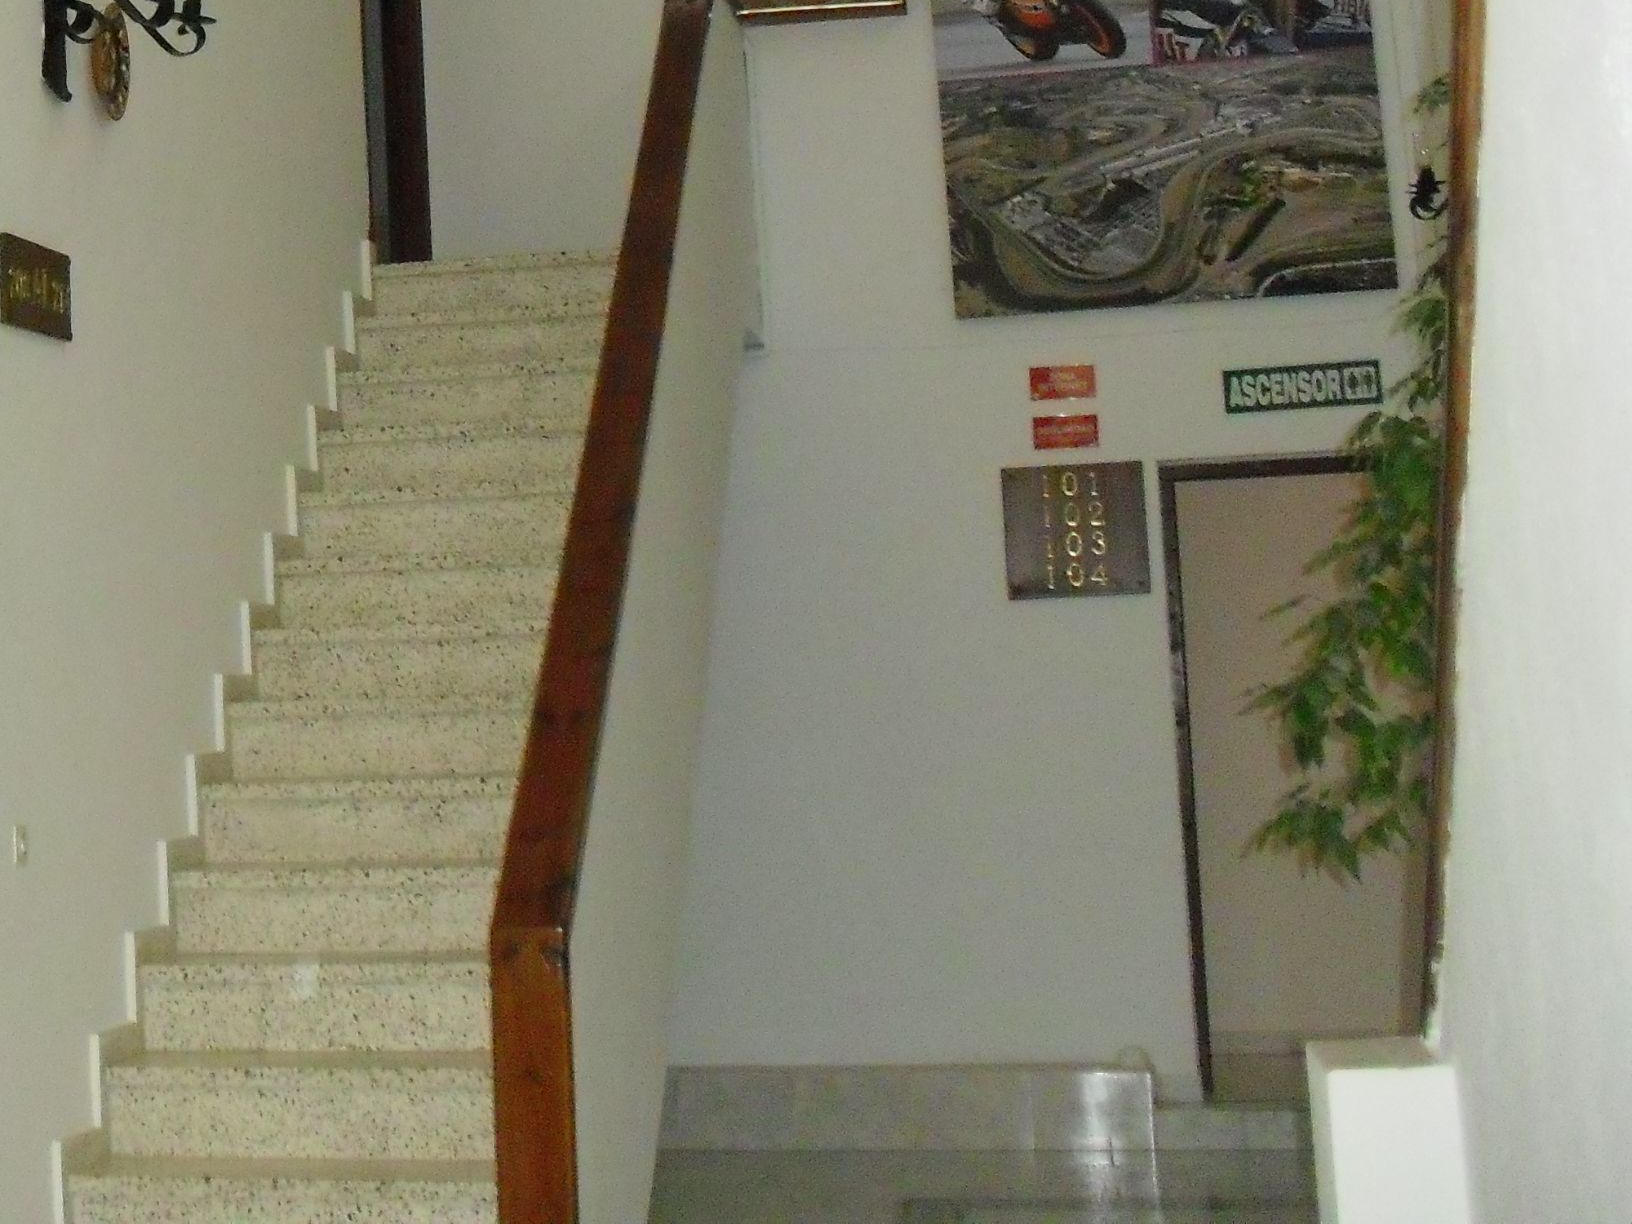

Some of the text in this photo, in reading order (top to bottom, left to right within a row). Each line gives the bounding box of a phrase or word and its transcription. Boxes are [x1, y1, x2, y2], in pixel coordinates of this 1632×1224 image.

[1229, 369, 1342, 407] ASCENSOR
[1042, 471, 1099, 497] 101
[1043, 501, 1105, 528] 102
[1044, 531, 1106, 557] 103
[1047, 563, 1108, 590] 104
